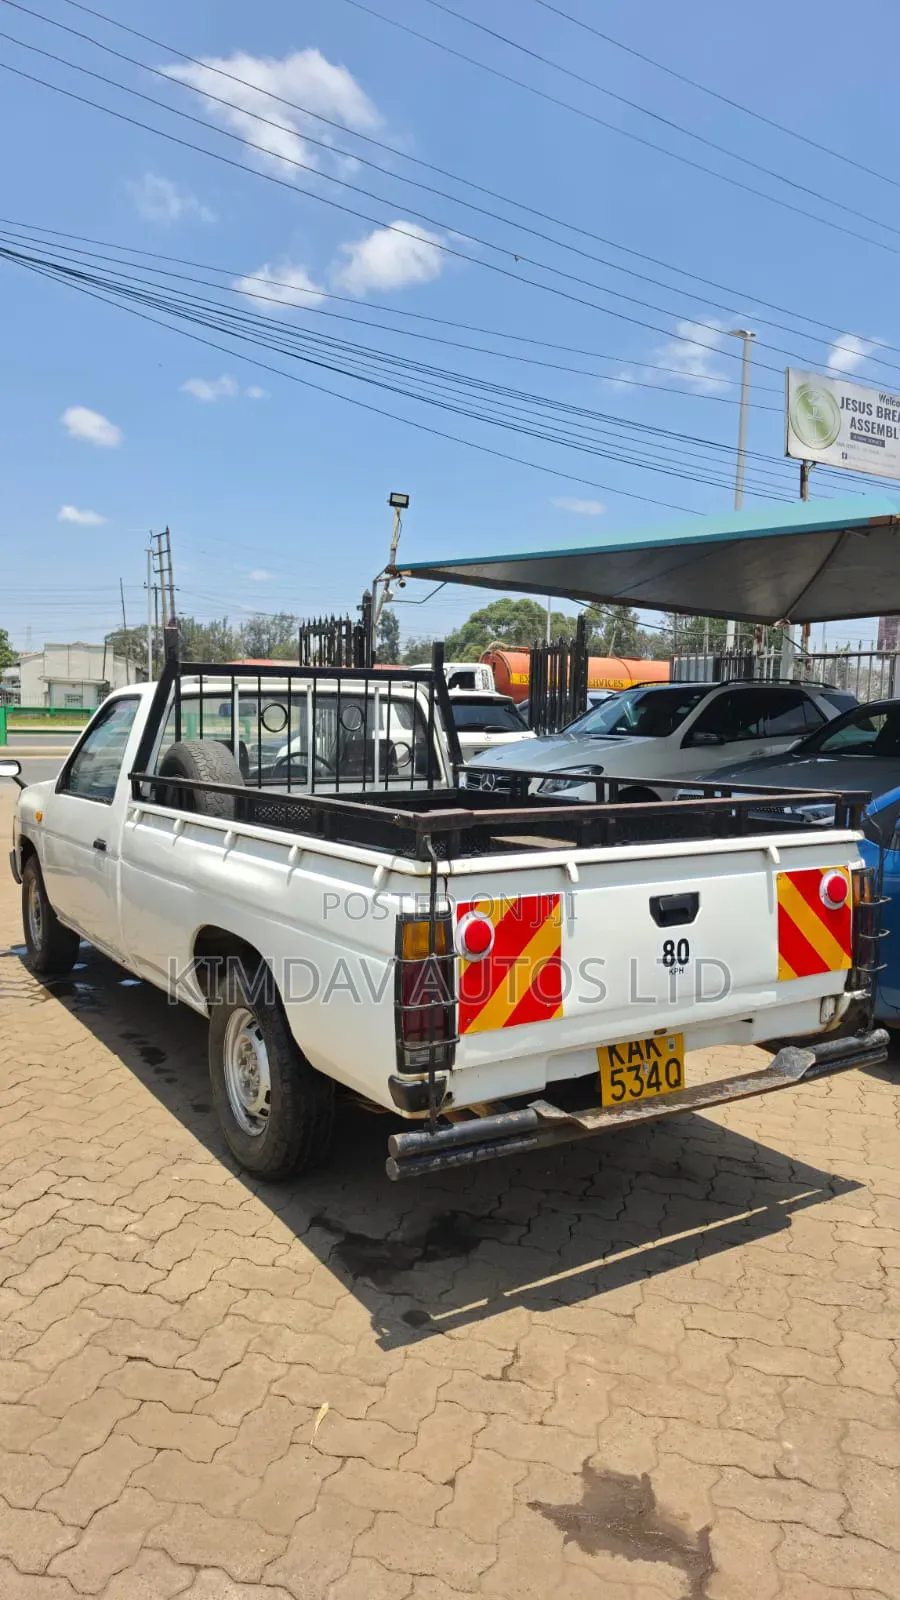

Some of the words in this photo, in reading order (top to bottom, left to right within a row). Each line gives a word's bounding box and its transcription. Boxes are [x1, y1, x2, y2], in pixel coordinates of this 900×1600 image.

[840, 396, 873, 416] JESUS
[850, 417, 900, 439] ASSEMBL
[588, 679, 624, 688] ERVICES
[662, 938, 690, 967] 80
[669, 967, 684, 975] KPH
[608, 1038, 662, 1067] KAK
[610, 1057, 682, 1101] 534Q
